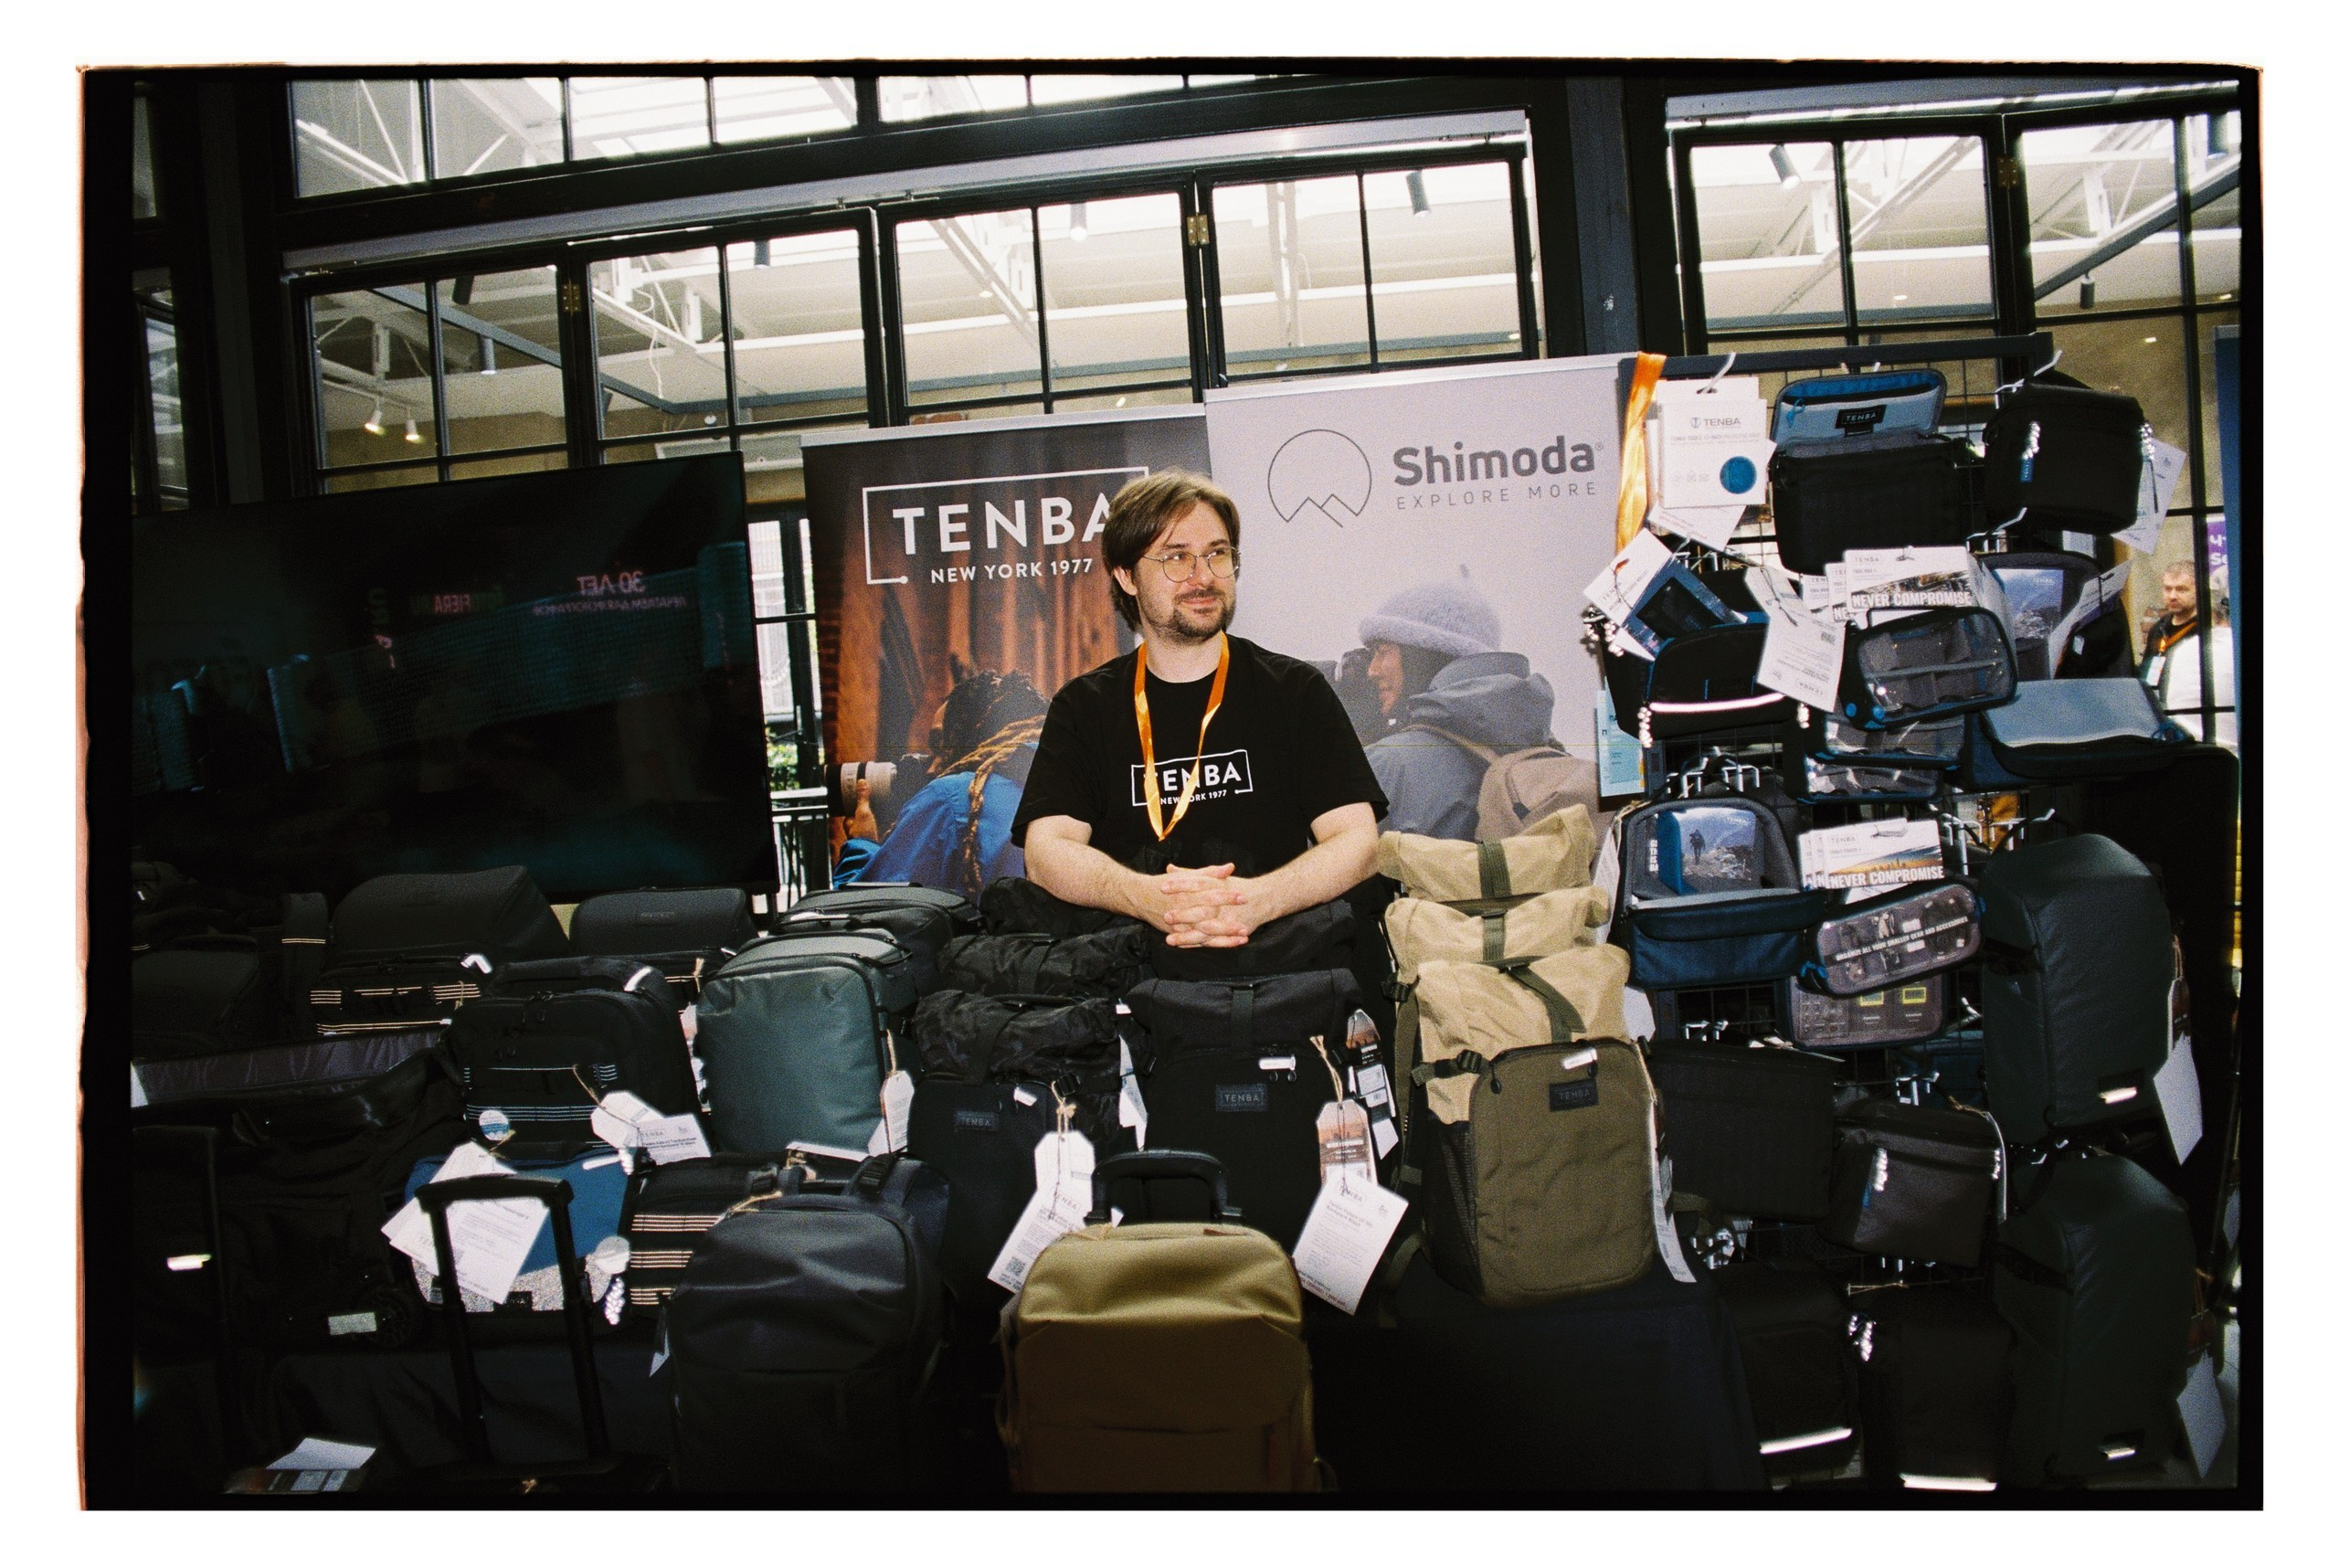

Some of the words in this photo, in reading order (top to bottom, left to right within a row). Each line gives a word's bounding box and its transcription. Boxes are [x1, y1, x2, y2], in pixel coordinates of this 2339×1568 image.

[1703, 417, 1741, 427] TENBA
[1845, 411, 1878, 422] TENBA
[1392, 435, 1595, 487] Shimoda
[1396, 488, 1509, 510] EXPLORE
[1529, 482, 1596, 499] MORE
[930, 565, 977, 585] NEW
[984, 561, 1042, 580] YORK
[1050, 558, 1094, 576] 1977
[1851, 593, 1890, 609] NEVER
[1894, 591, 1972, 607] COMPROMISE
[1144, 761, 1242, 792] ENBA
[1159, 796, 1179, 805] NEW
[1209, 789, 1227, 799] 1977
[1826, 873, 1867, 889] NEVER
[1869, 865, 1944, 885] COMPROMISE
[1224, 1093, 1260, 1104] TENBA
